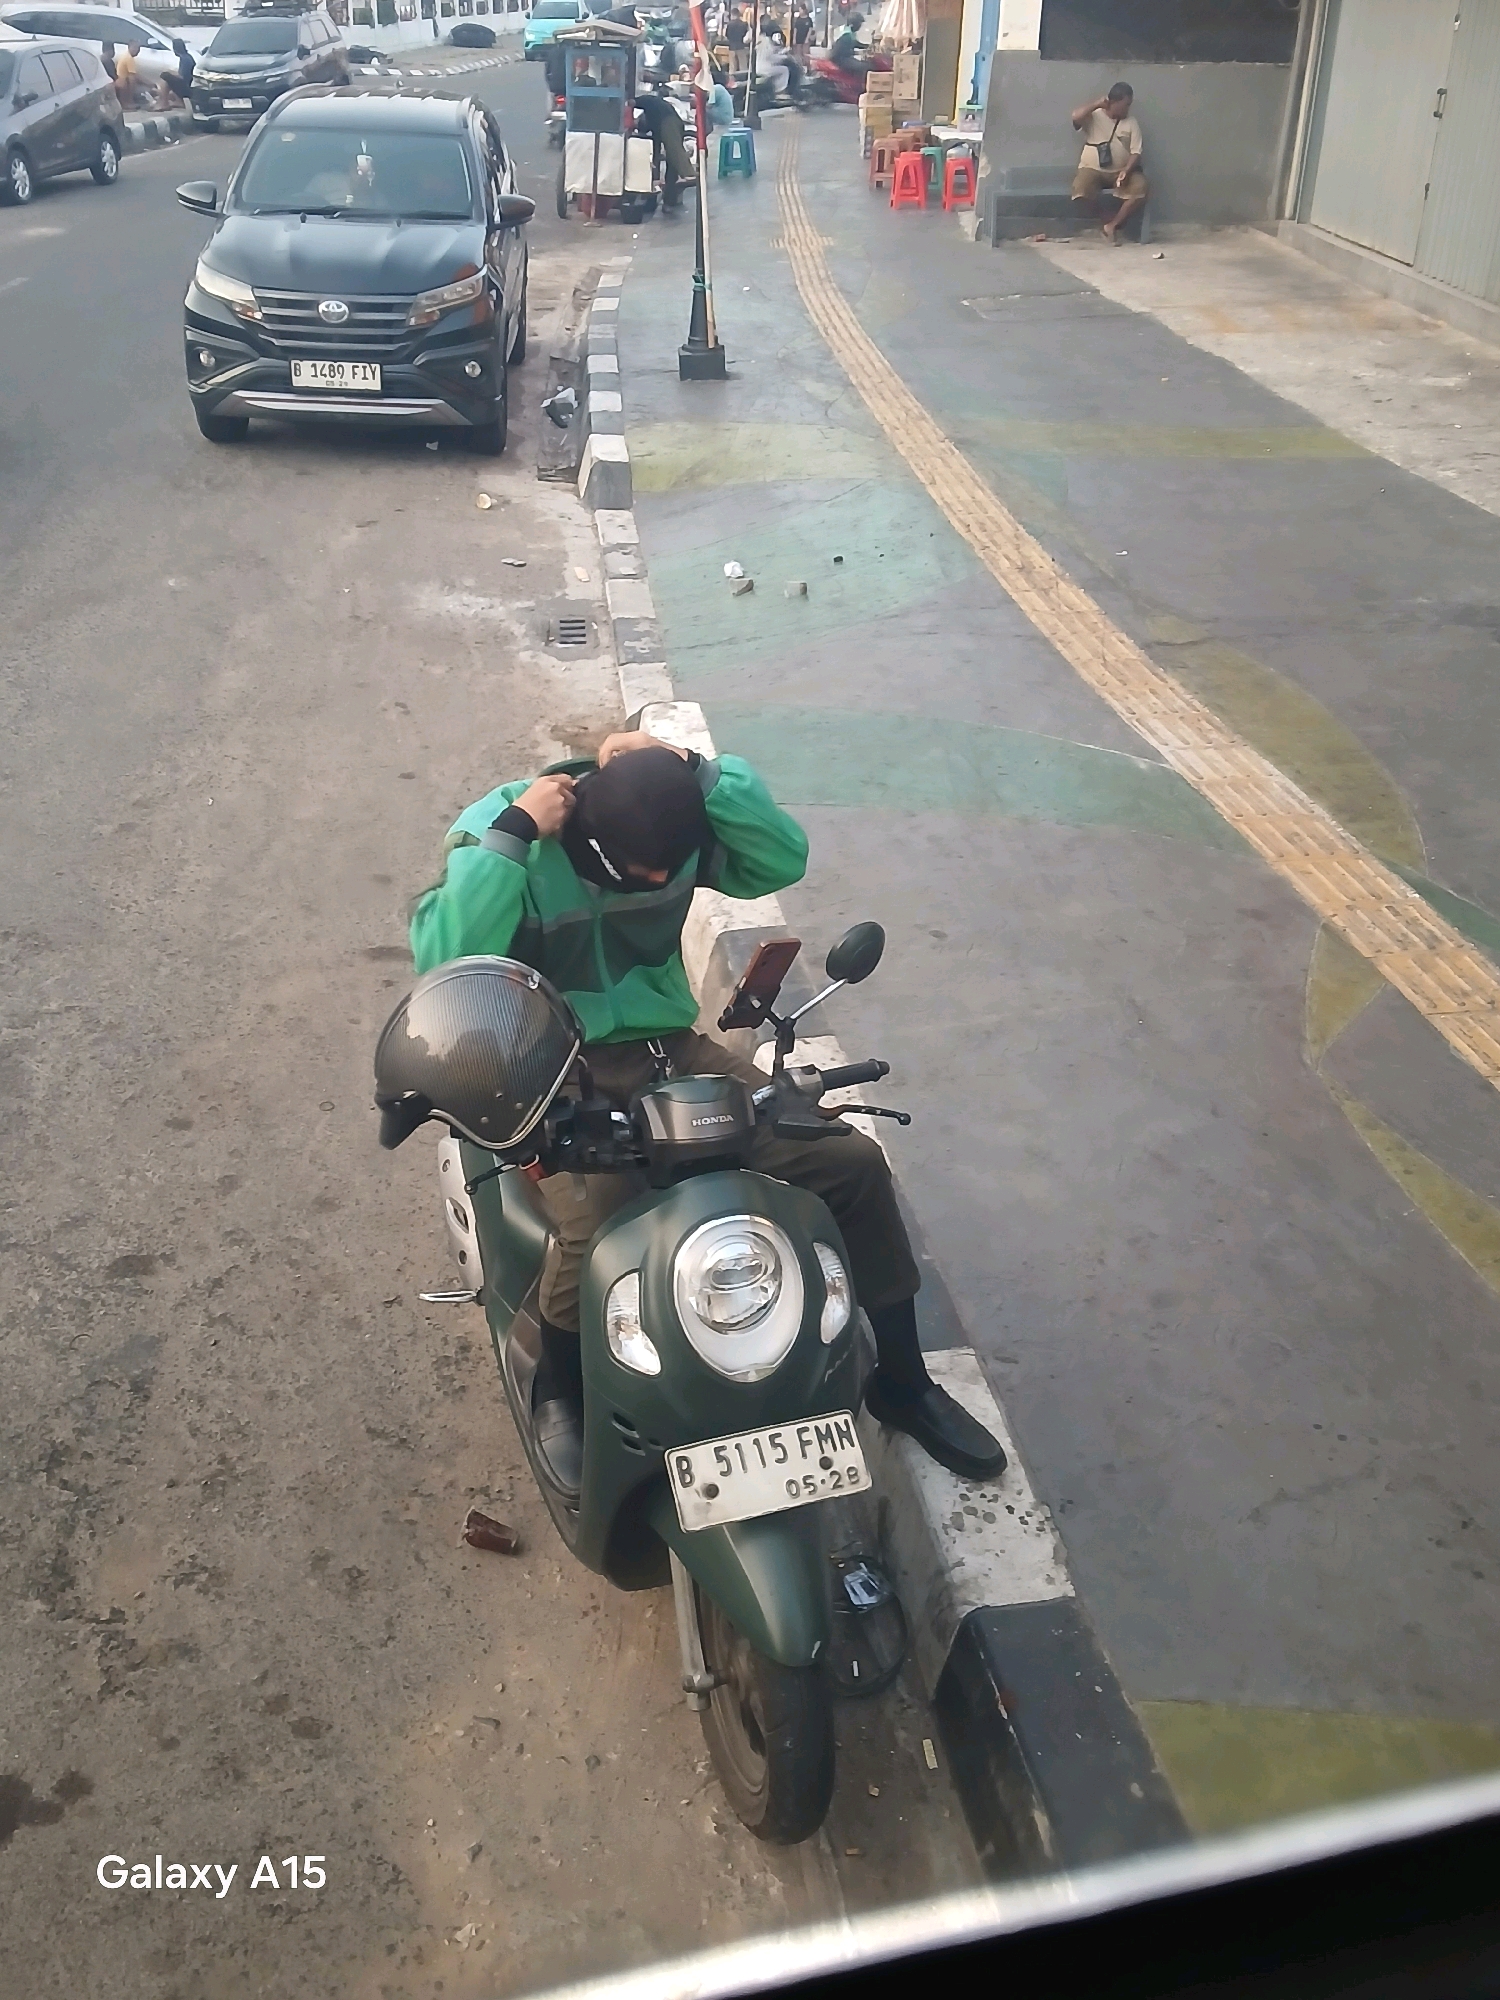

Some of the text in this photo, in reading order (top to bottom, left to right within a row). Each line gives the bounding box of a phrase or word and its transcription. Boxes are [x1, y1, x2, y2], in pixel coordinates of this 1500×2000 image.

[293, 362, 301, 377] B
[310, 363, 344, 378] 1489
[692, 1114, 734, 1127] HONDA
[675, 1418, 855, 1488] B 5115 FMN
